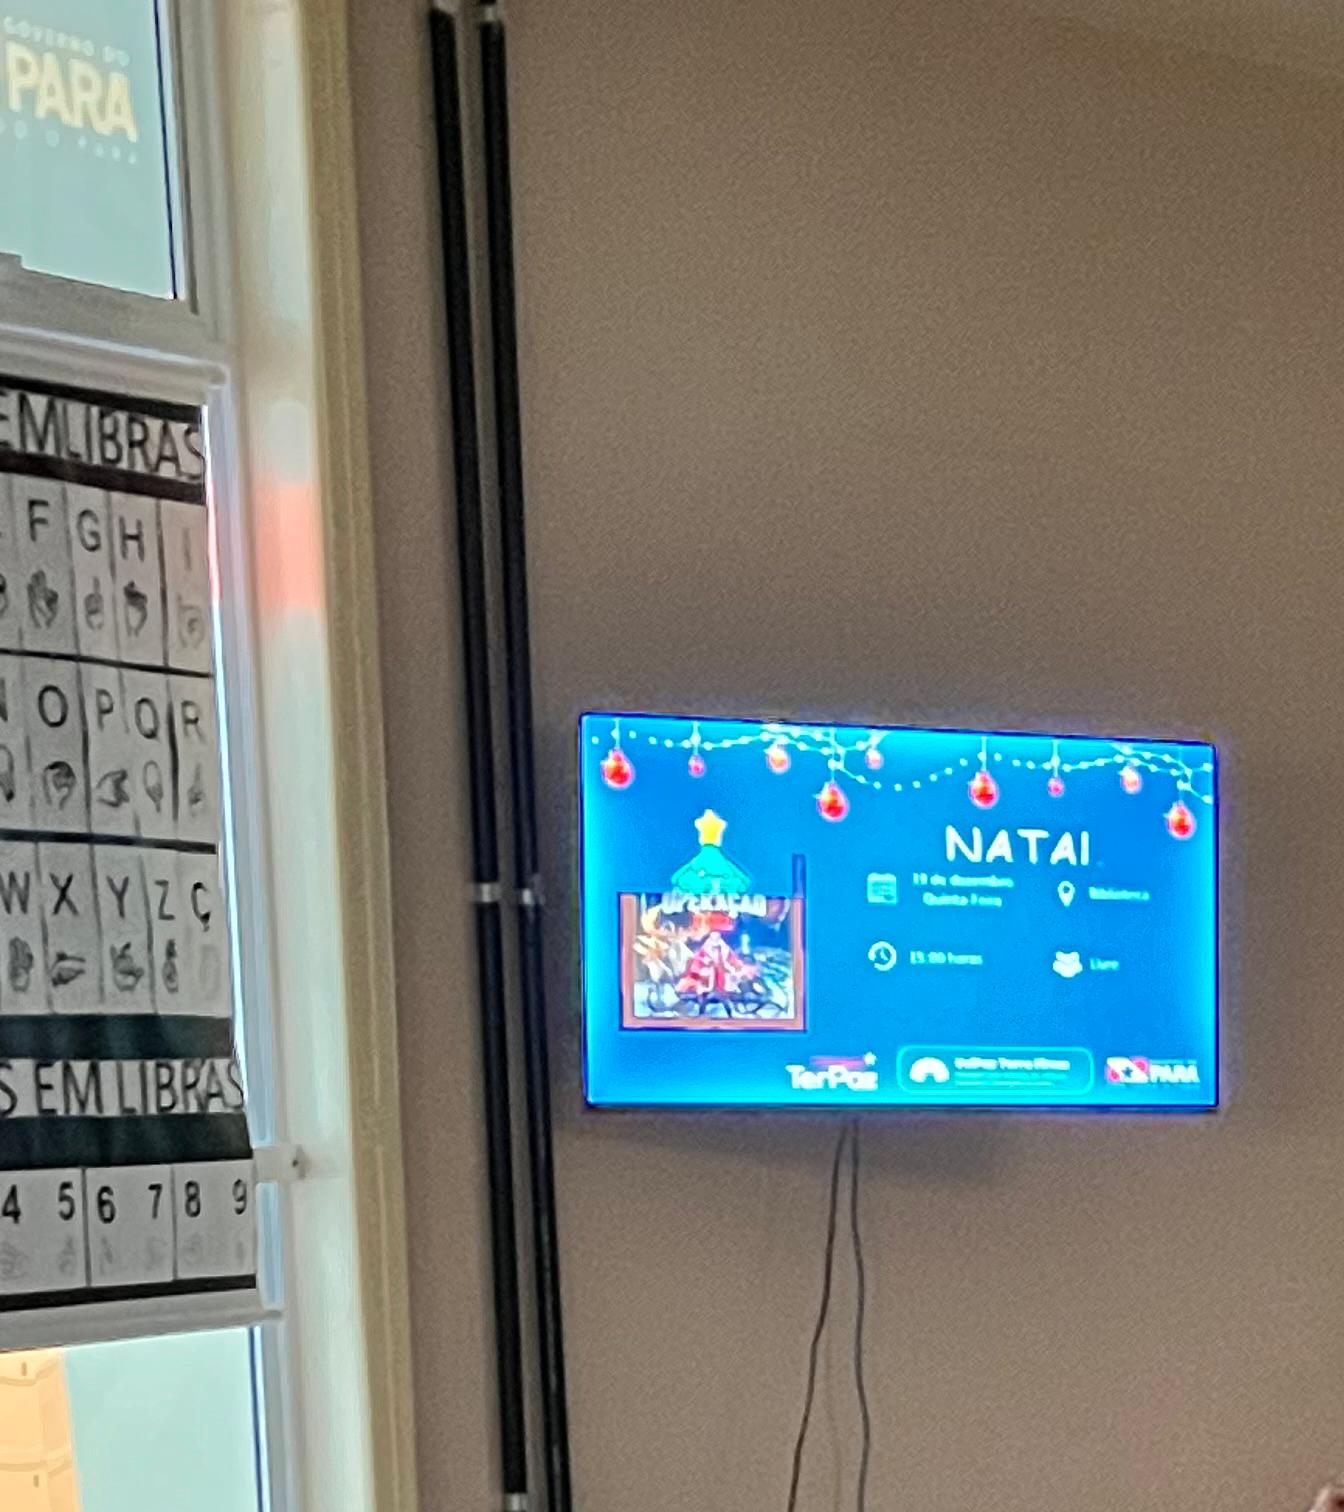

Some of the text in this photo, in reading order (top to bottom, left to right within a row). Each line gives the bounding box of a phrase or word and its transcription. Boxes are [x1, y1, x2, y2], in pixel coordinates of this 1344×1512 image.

[27, 498, 49, 543] F
[77, 508, 100, 553] G
[118, 514, 145, 562] H
[37, 683, 69, 728] O
[95, 687, 114, 735] P
[180, 700, 208, 748] R
[50, 872, 79, 916] X
[106, 874, 130, 918] Y
[155, 879, 175, 921] Z
[1, 1178, 248, 1224] 4 5 6 7 8 9
